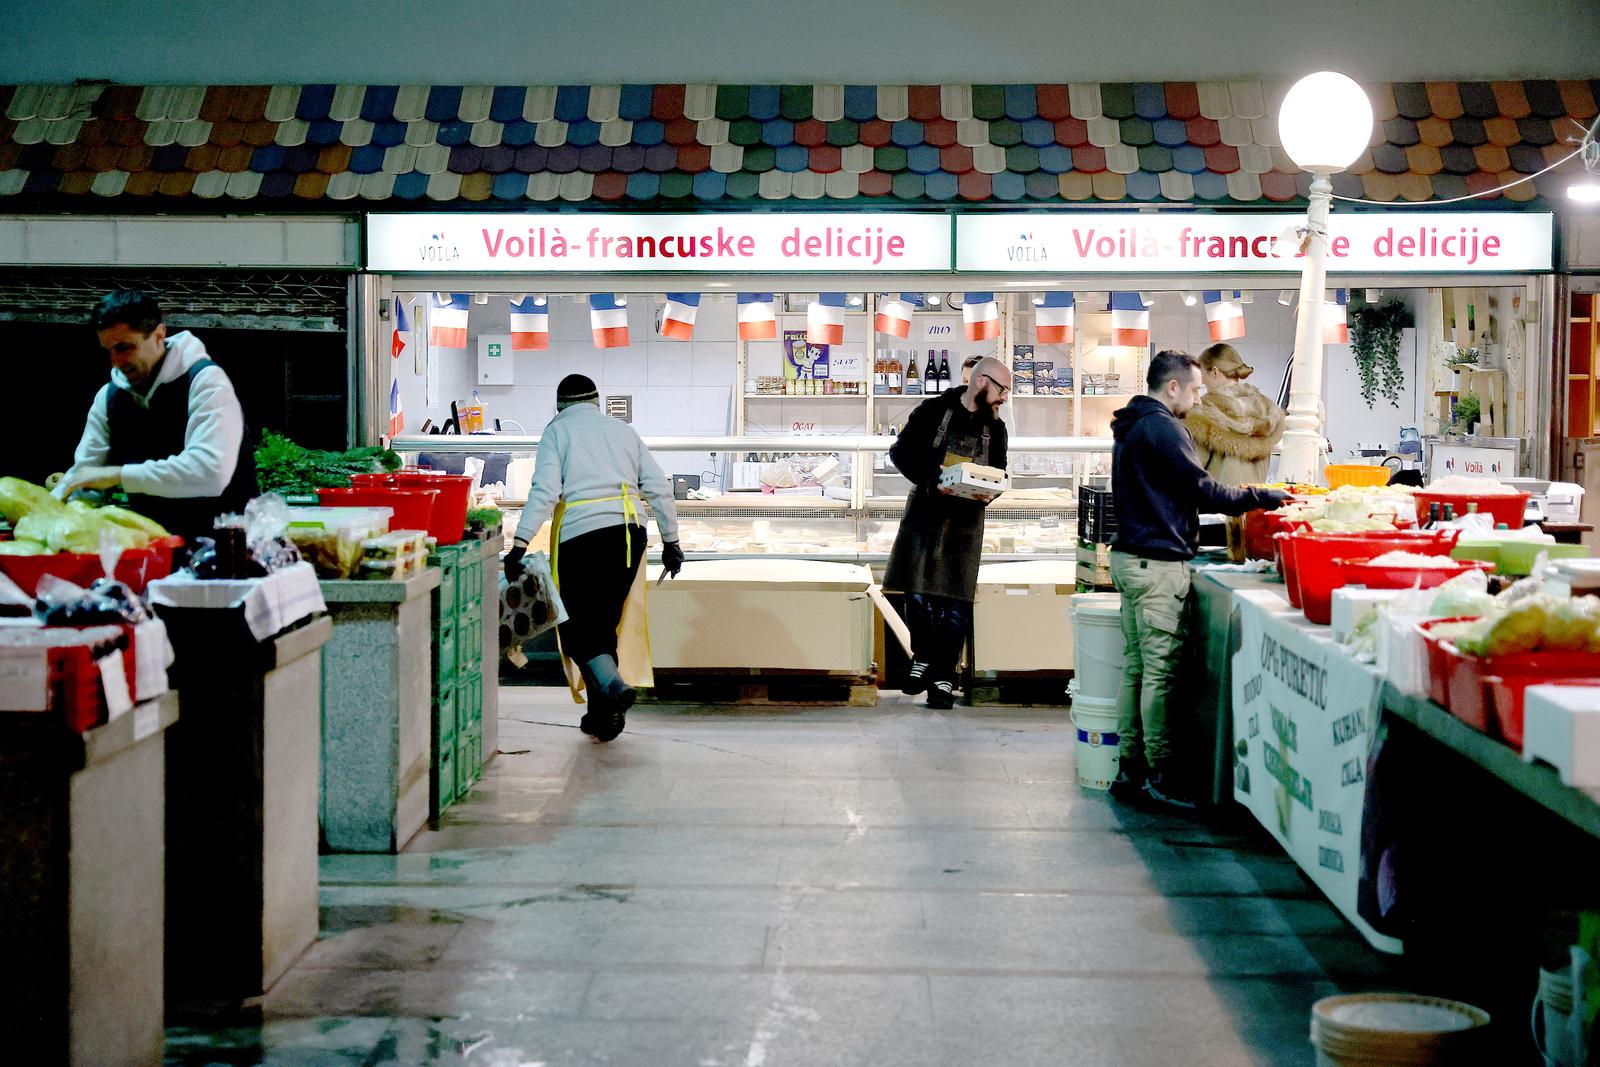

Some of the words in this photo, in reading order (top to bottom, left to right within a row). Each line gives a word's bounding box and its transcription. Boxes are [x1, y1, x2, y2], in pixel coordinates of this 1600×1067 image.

[781, 227, 905, 265] delicije
[1072, 227, 1350, 259] Voilà-france
[1373, 227, 1501, 265] delicije
[1464, 461, 1483, 474] Voilà
